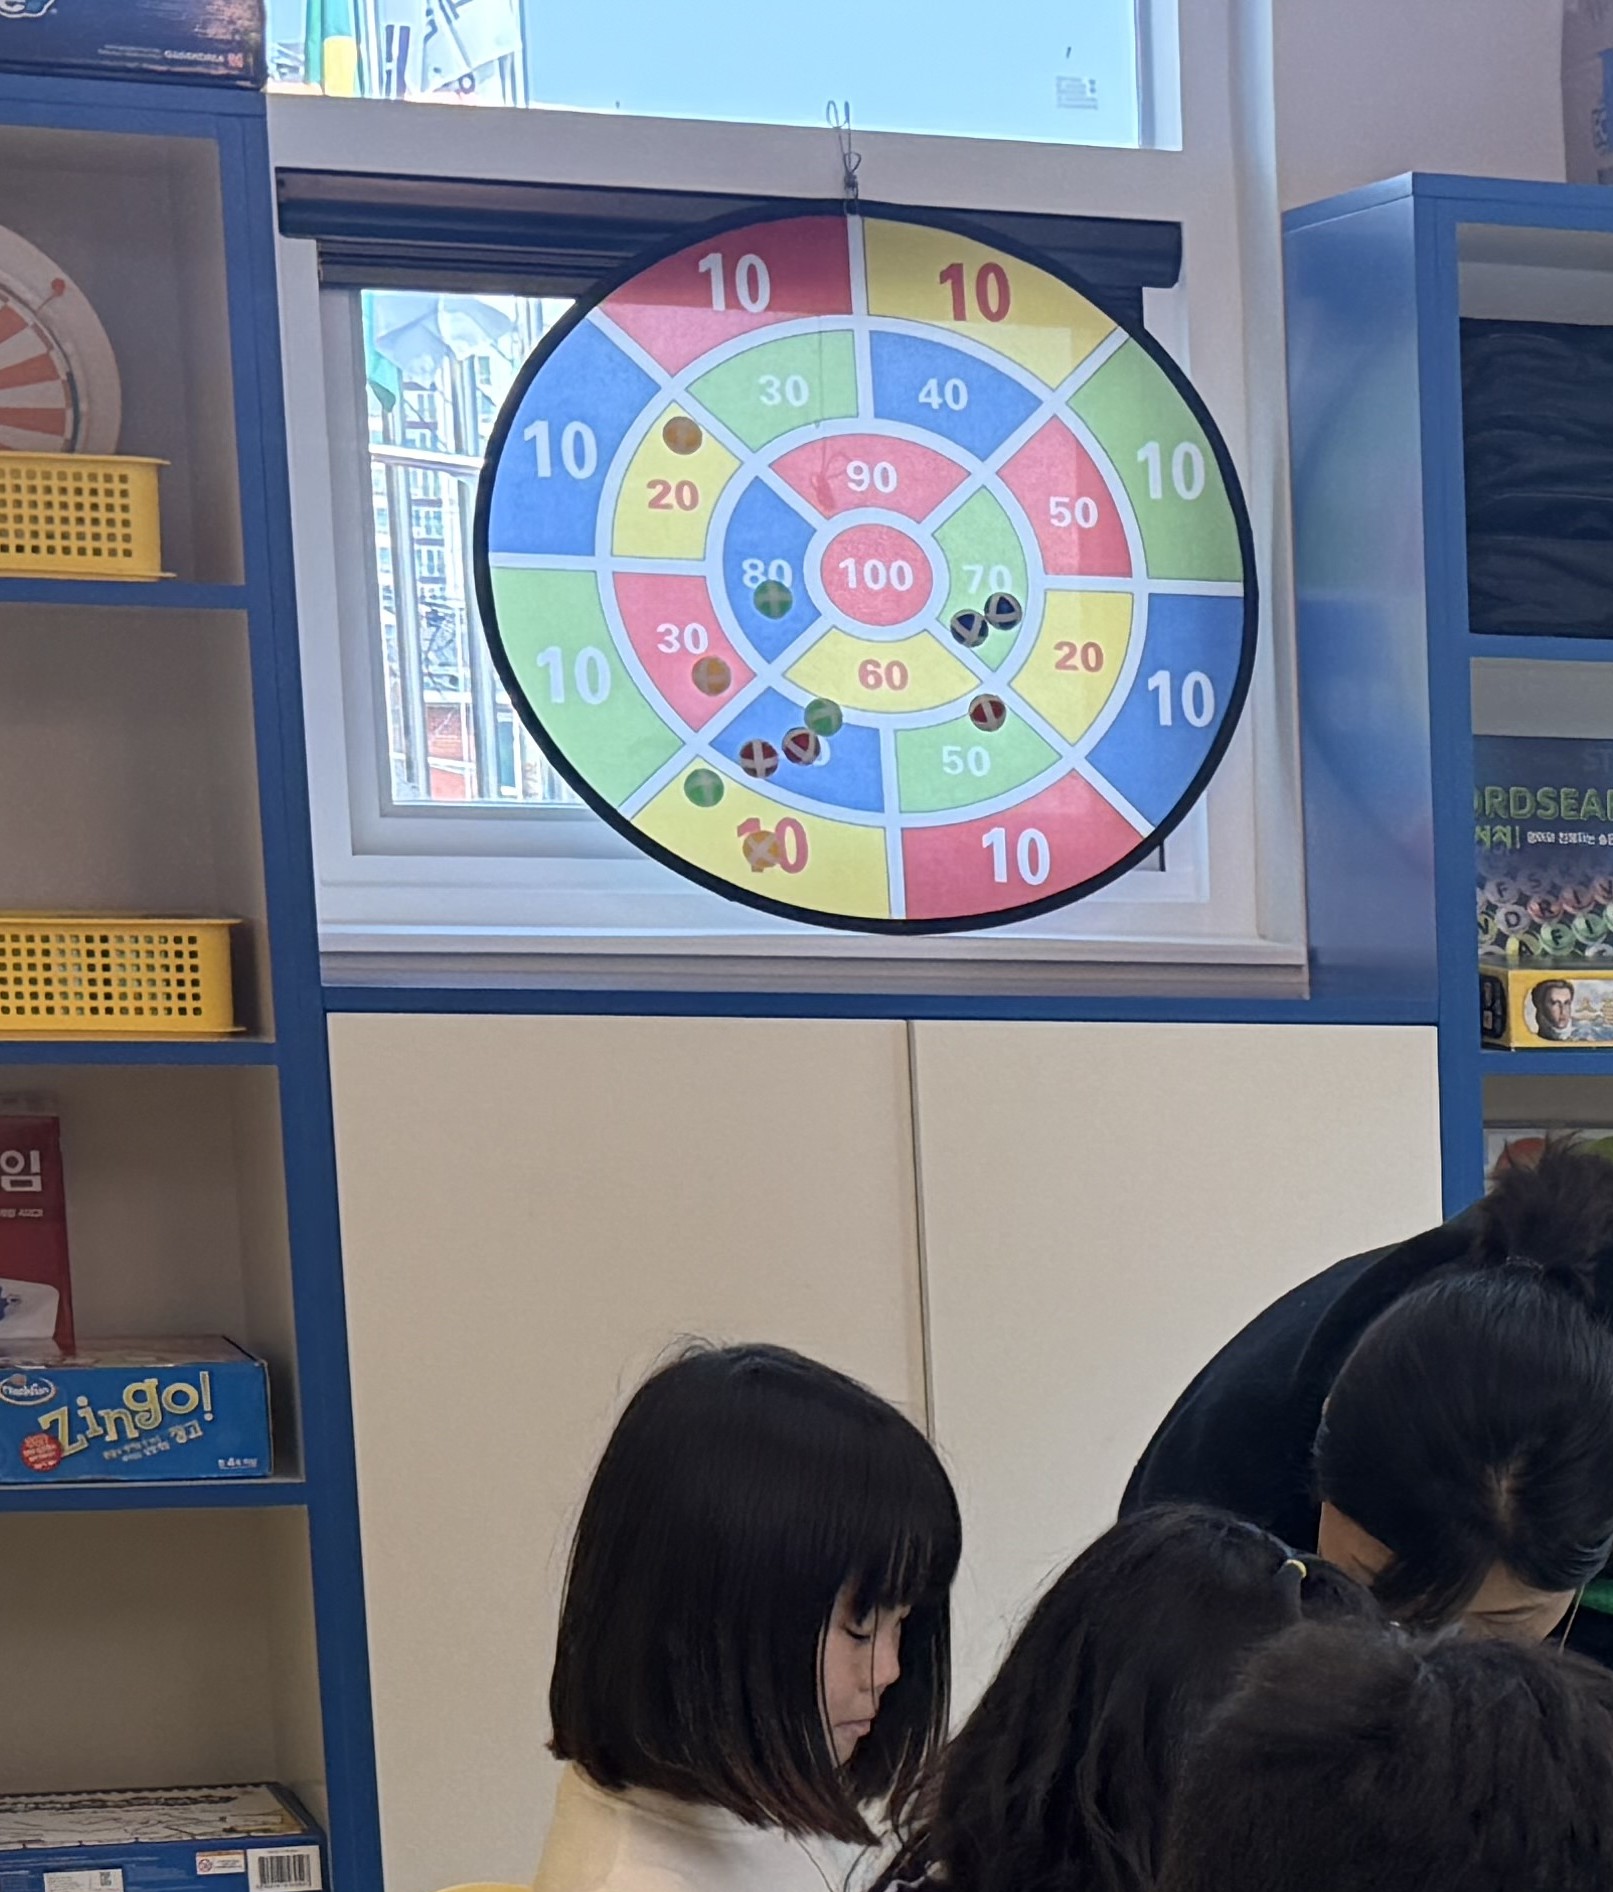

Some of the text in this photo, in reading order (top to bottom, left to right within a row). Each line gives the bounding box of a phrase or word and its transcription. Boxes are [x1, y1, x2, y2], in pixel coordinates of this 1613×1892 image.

[698, 253, 770, 313] 10
[939, 262, 1013, 323] 10
[758, 373, 810, 407] 30
[917, 377, 969, 412] 40
[523, 420, 598, 480] 10
[845, 460, 899, 495] 90
[1136, 441, 1206, 502] 10
[647, 479, 700, 512] 20
[1048, 496, 1099, 530] 50
[742, 558, 793, 590] 80
[838, 557, 914, 593] 100
[962, 564, 1013, 598] 70
[656, 622, 709, 655] 30
[1053, 641, 1104, 674] 20
[536, 645, 612, 706] 10
[857, 659, 910, 692] 60
[1147, 670, 1216, 729] 10
[941, 744, 992, 778] 50
[981, 827, 1052, 886] 10
[37, 1371, 214, 1457] Zingo!
